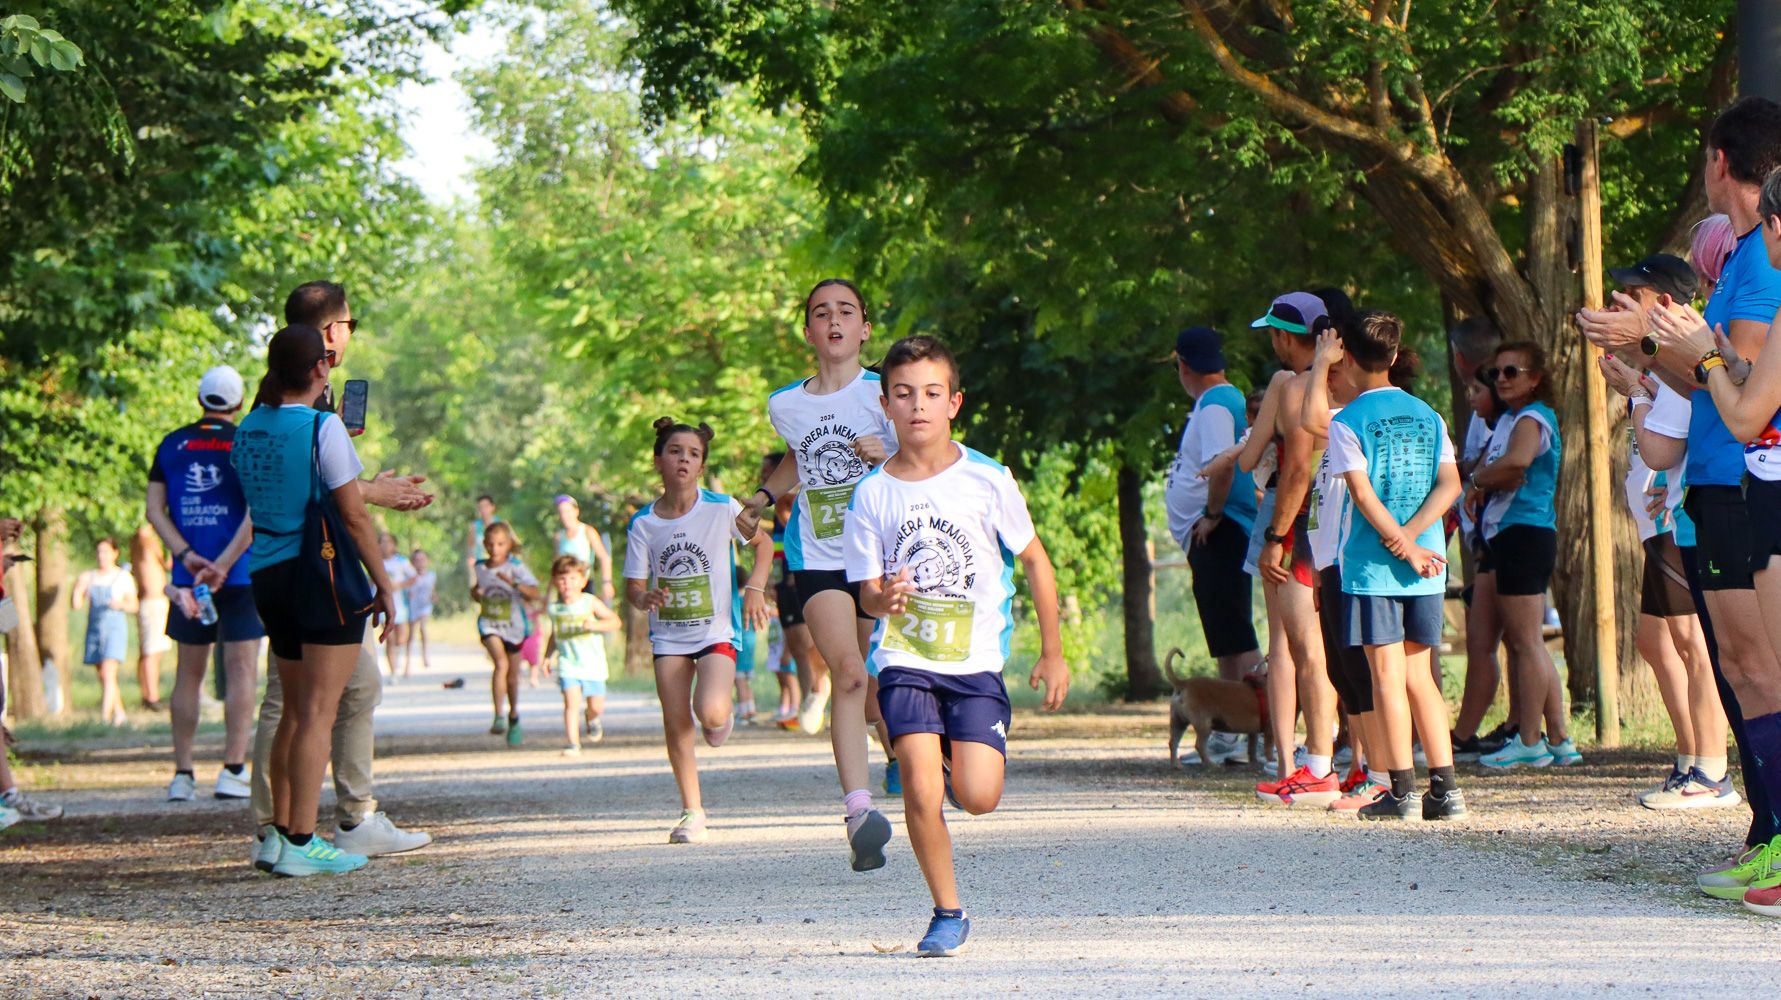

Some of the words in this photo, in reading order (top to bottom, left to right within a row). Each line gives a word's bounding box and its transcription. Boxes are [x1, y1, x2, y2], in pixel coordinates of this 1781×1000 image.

[820, 414, 835, 422] 2026
[799, 425, 830, 462] CARRERA
[820, 502, 848, 524] 25
[910, 503, 930, 512] 2026
[929, 516, 974, 570] MEMORIAL
[664, 590, 702, 608] 253
[901, 612, 956, 644] 281
